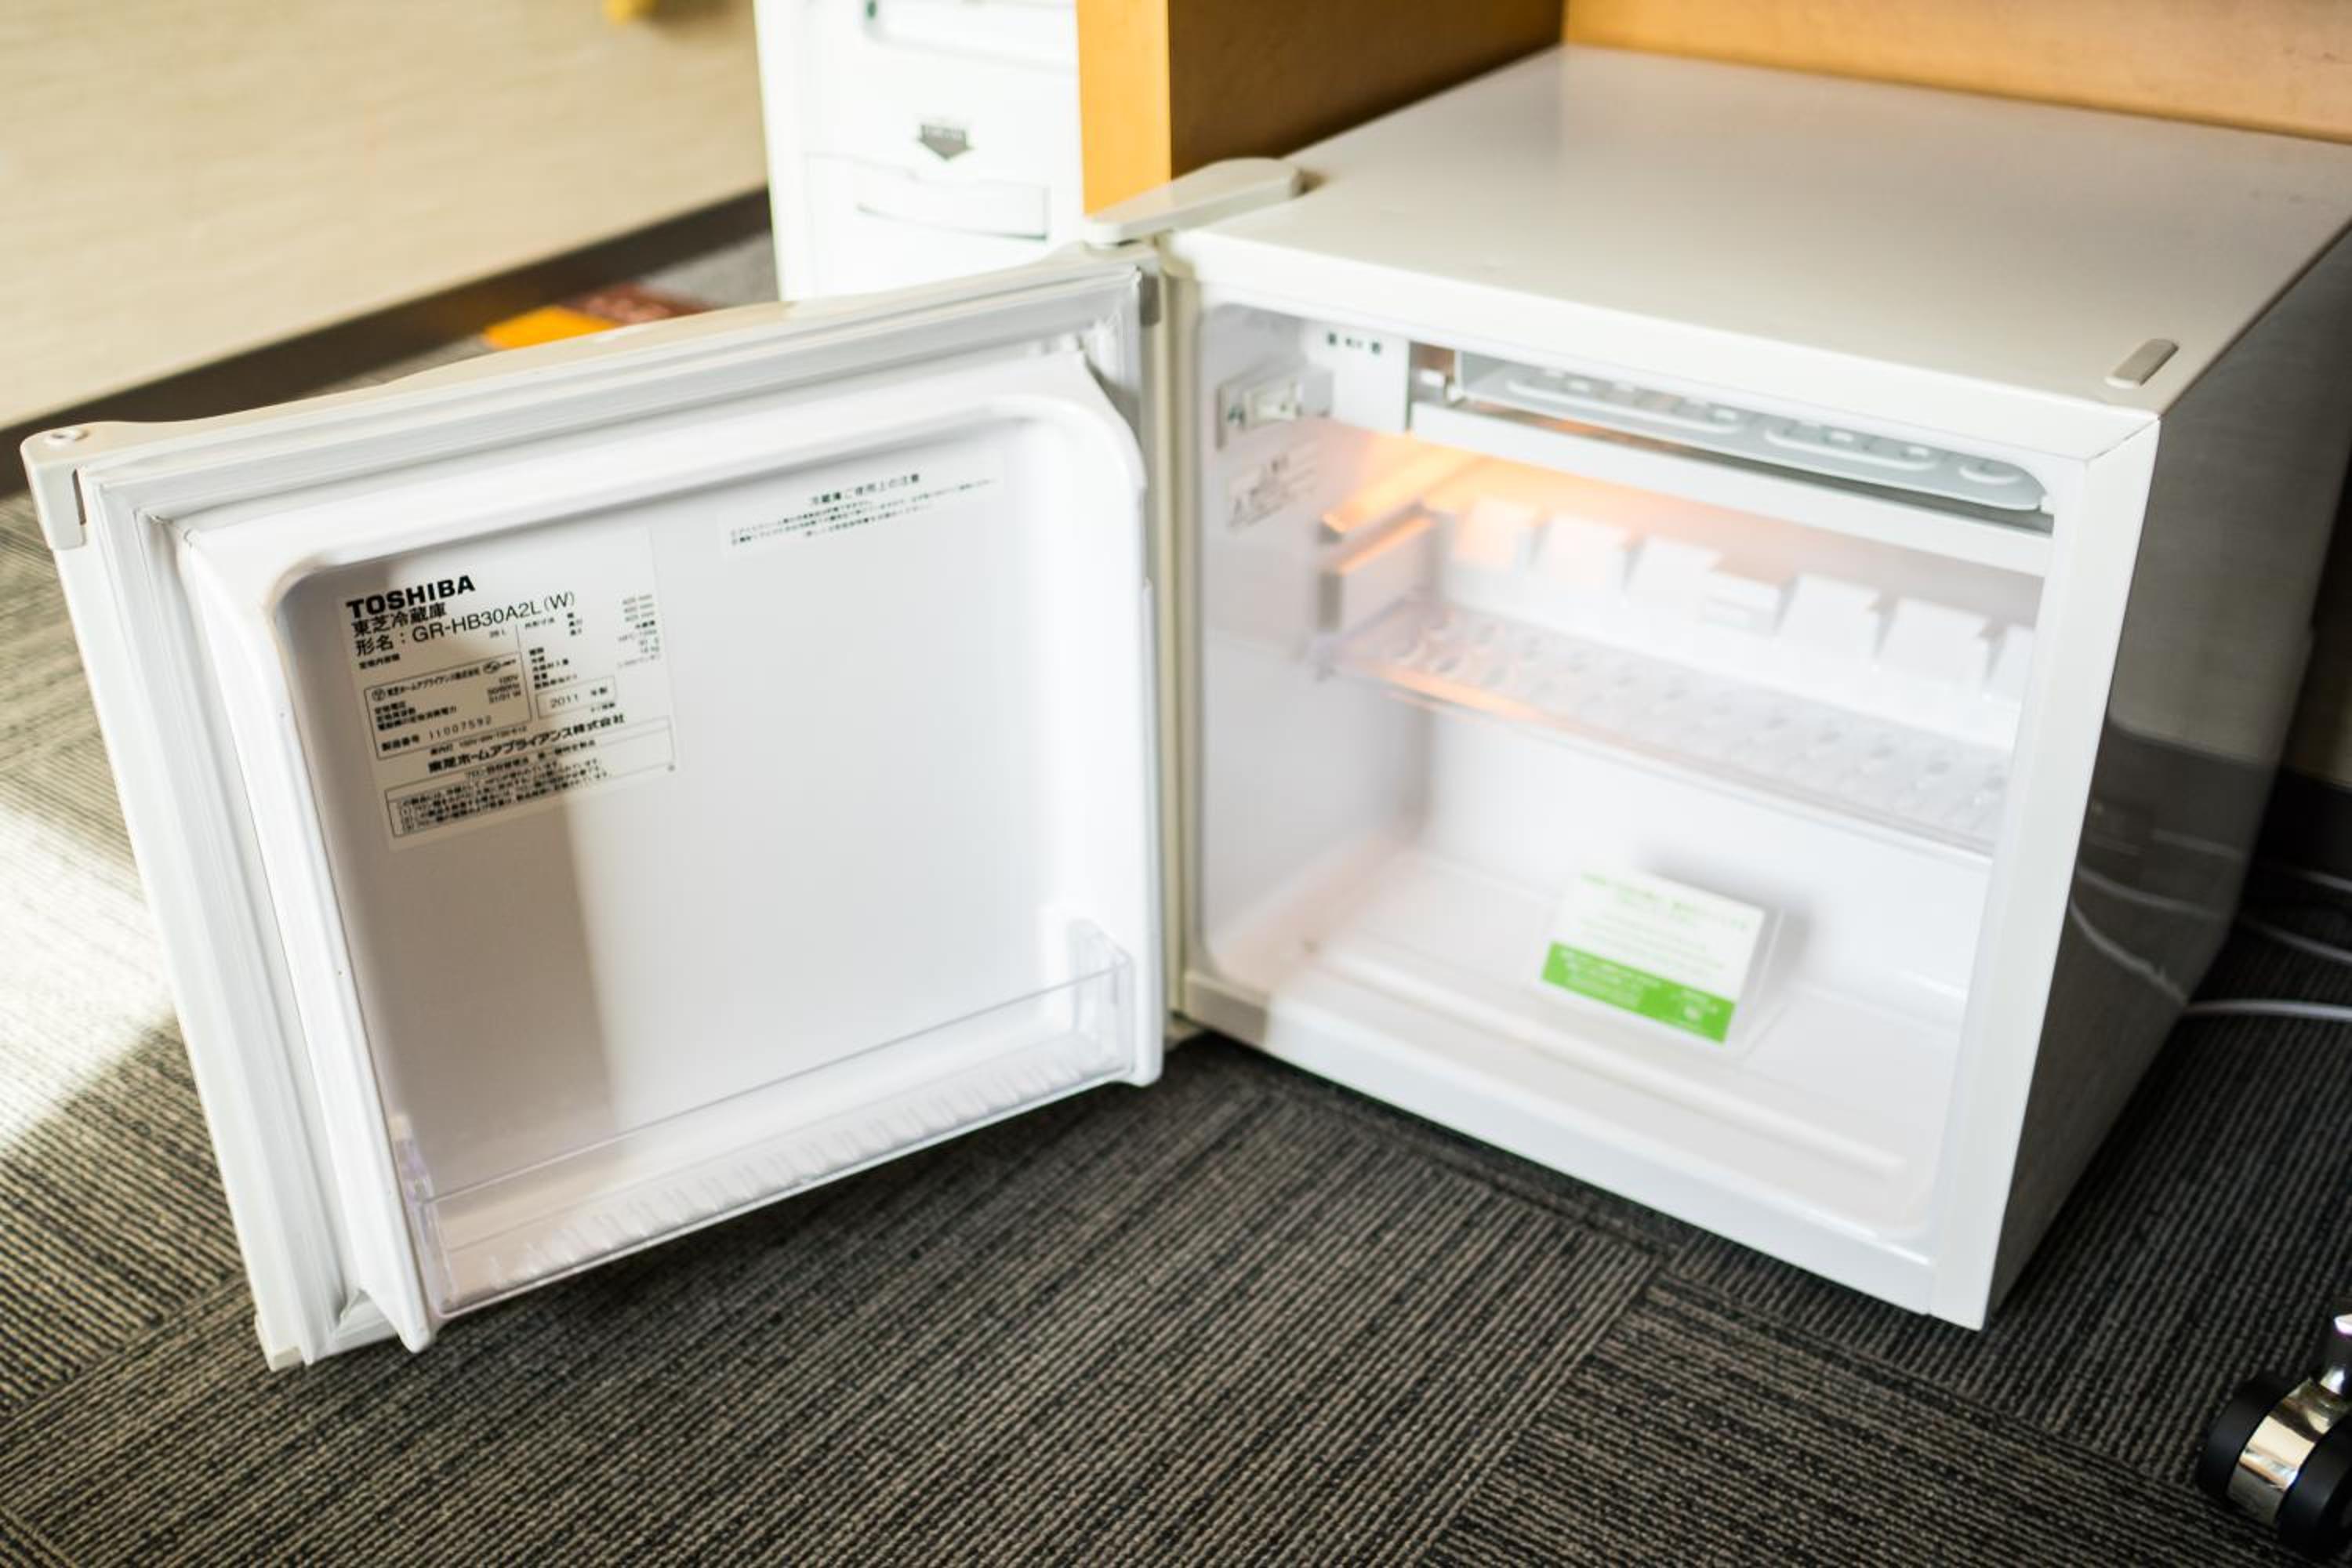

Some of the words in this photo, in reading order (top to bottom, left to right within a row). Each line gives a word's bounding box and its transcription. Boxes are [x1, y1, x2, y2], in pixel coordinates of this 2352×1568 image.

[346, 575, 475, 618] TOSHIBA
[351, 602, 447, 638] 東芝冷蔵庫
